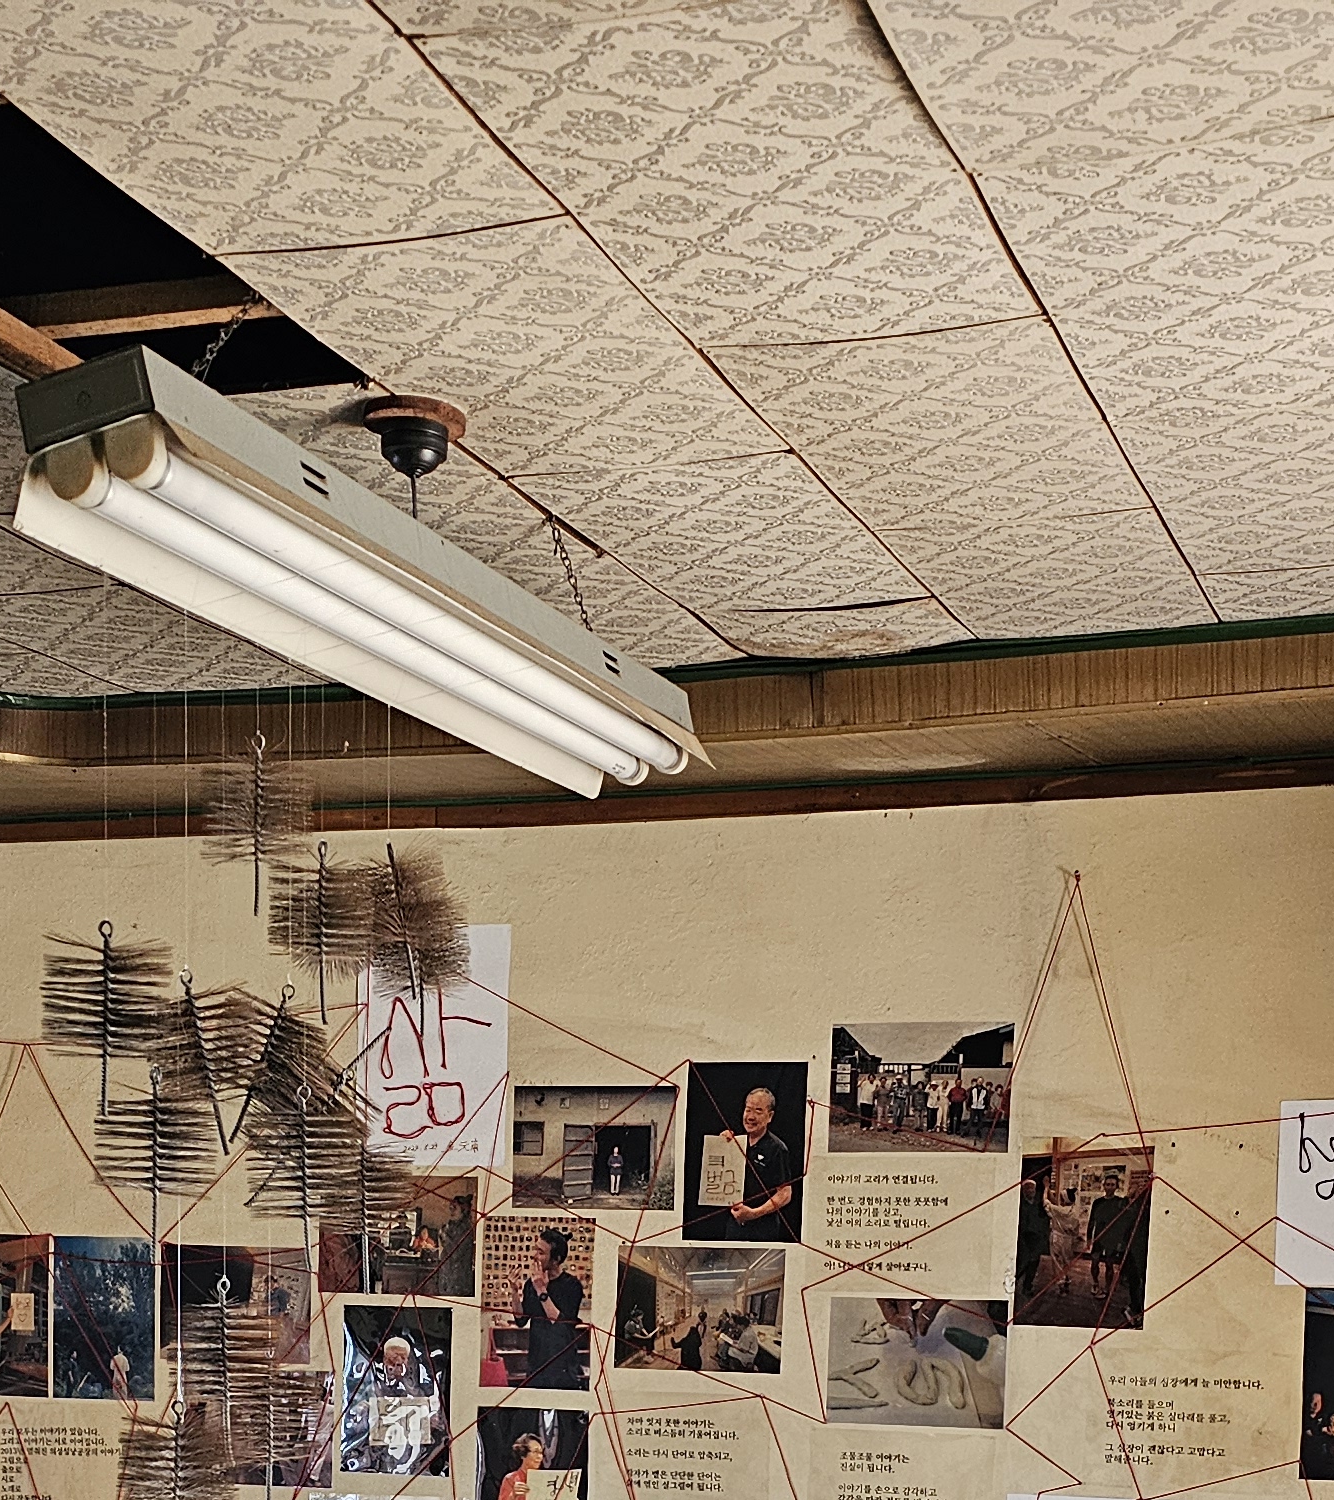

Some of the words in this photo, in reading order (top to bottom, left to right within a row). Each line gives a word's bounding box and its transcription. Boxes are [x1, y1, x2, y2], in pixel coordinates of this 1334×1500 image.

[827, 1174, 861, 1184] 이야기의
[864, 1175, 889, 1184] 고리가
[892, 1175, 938, 1184] 연결됩니다.
[838, 1196, 855, 1205] 번도
[857, 1196, 891, 1206] 경험하지
[894, 1197, 910, 1206] 못한
[827, 1207, 842, 1216] 나의
[846, 1207, 879, 1217] 이야기를
[865, 1219, 890, 1227] 소리로
[826, 1240, 841, 1249] 처음
[845, 1240, 861, 1249] 듣는
[865, 1240, 880, 1249] 나의
[824, 1261, 835, 1270] 아!
[1108, 1376, 1126, 1386] 우리
[1129, 1376, 1157, 1387] 아들의
[1160, 1377, 1198, 1388] 심장에게
[1214, 1378, 1264, 1390] 미안합니다.
[1146, 1410, 1164, 1421] 붉은
[627, 1417, 643, 1425] 차마
[665, 1418, 680, 1427] 못한
[683, 1419, 715, 1429] 이야기는
[1106, 1421, 1124, 1430] 다시
[1158, 1423, 1176, 1433] 하니
[1, 1428, 14, 1436] 우리
[69, 1428, 100, 1436] 있습니다.
[626, 1427, 651, 1436] 소리로
[654, 1428, 685, 1438] 비스듬히
[688, 1429, 739, 1440] 기울어집니다.
[626, 1448, 650, 1457] 소리는
[653, 1449, 668, 1458] 다시
[671, 1449, 695, 1459] 단어로
[698, 1451, 732, 1462] 압축되고,
[1105, 1443, 1113, 1451] 그
[1147, 1445, 1185, 1455] 괜찮다고
[1187, 1446, 1226, 1457] 고맙다고
[875, 1453, 910, 1463] 이야기는
[867, 1464, 895, 1473] 됩니다.
[670, 1470, 694, 1480] 단단한
[697, 1471, 722, 1481] 단어는
[697, 1482, 724, 1493] 됩니다.
[838, 1483, 872, 1494] 이야기를
[875, 1486, 900, 1495] 손으로
[903, 1487, 937, 1497] 감각하고
